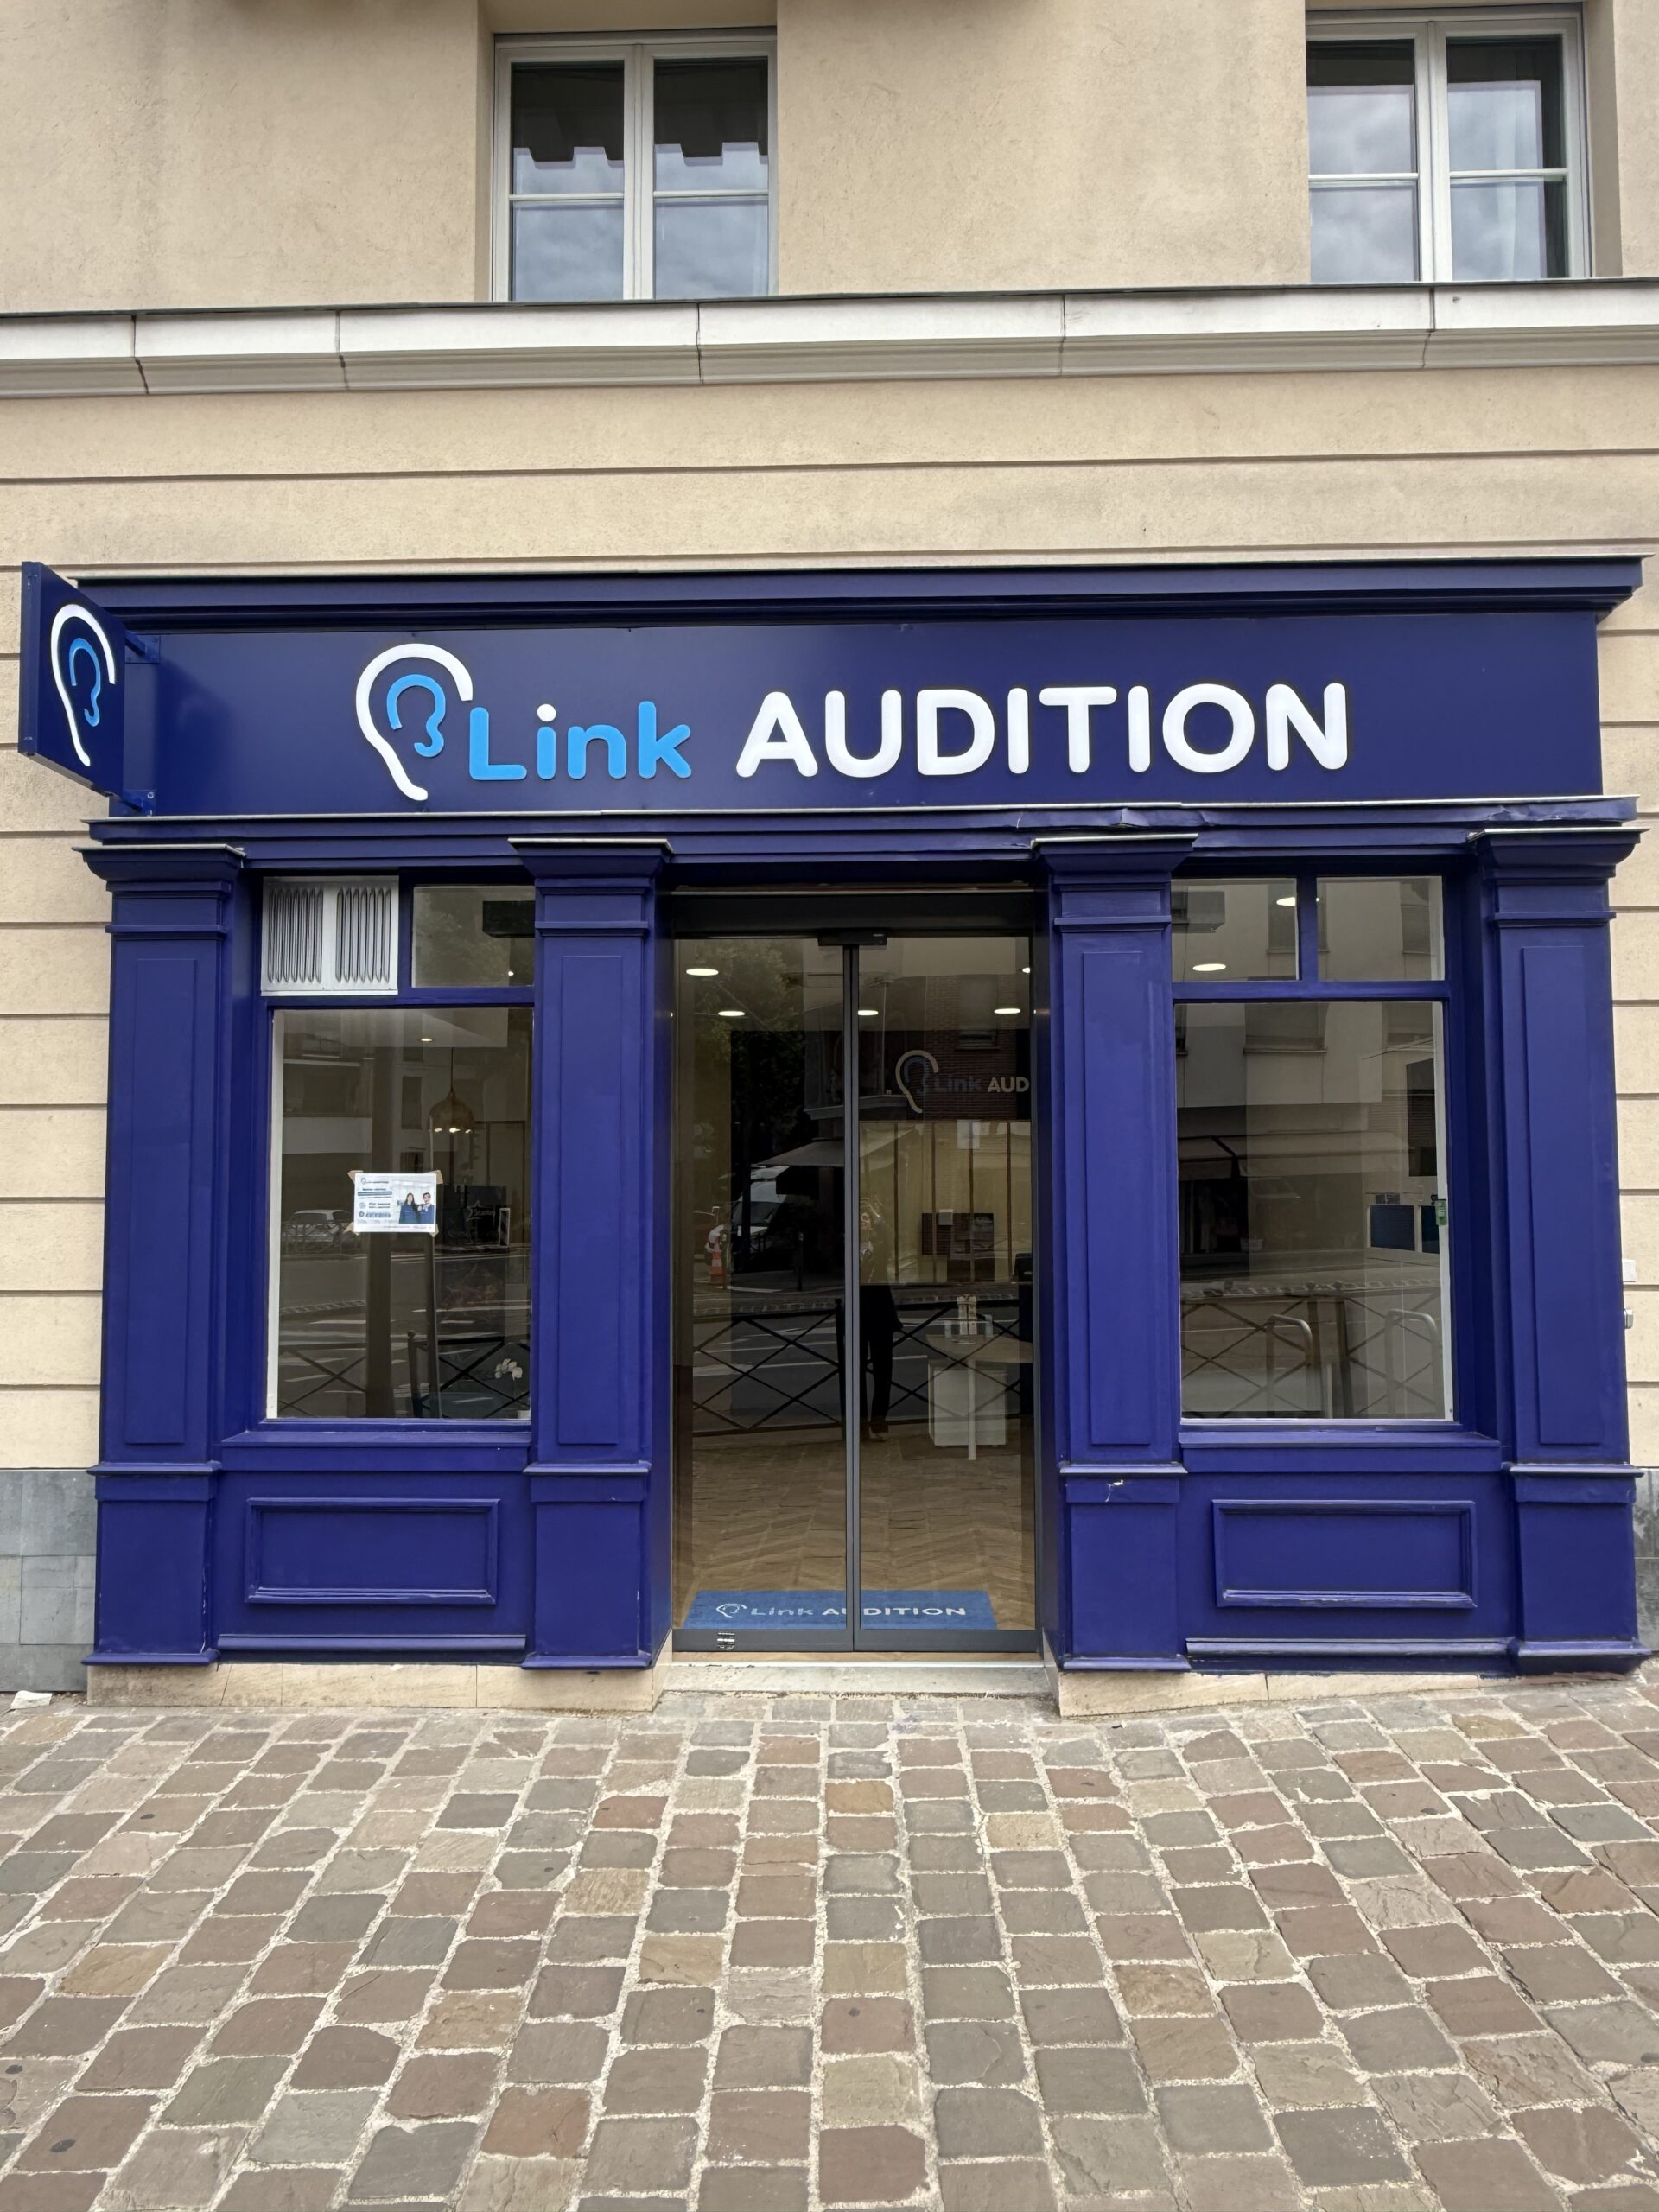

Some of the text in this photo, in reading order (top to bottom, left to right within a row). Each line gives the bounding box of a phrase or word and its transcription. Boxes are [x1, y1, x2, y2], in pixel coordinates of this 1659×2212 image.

[469, 683, 1349, 780] Link AUDITION
[988, 1077, 1030, 1093] AUD
[751, 1607, 814, 1616] Link
